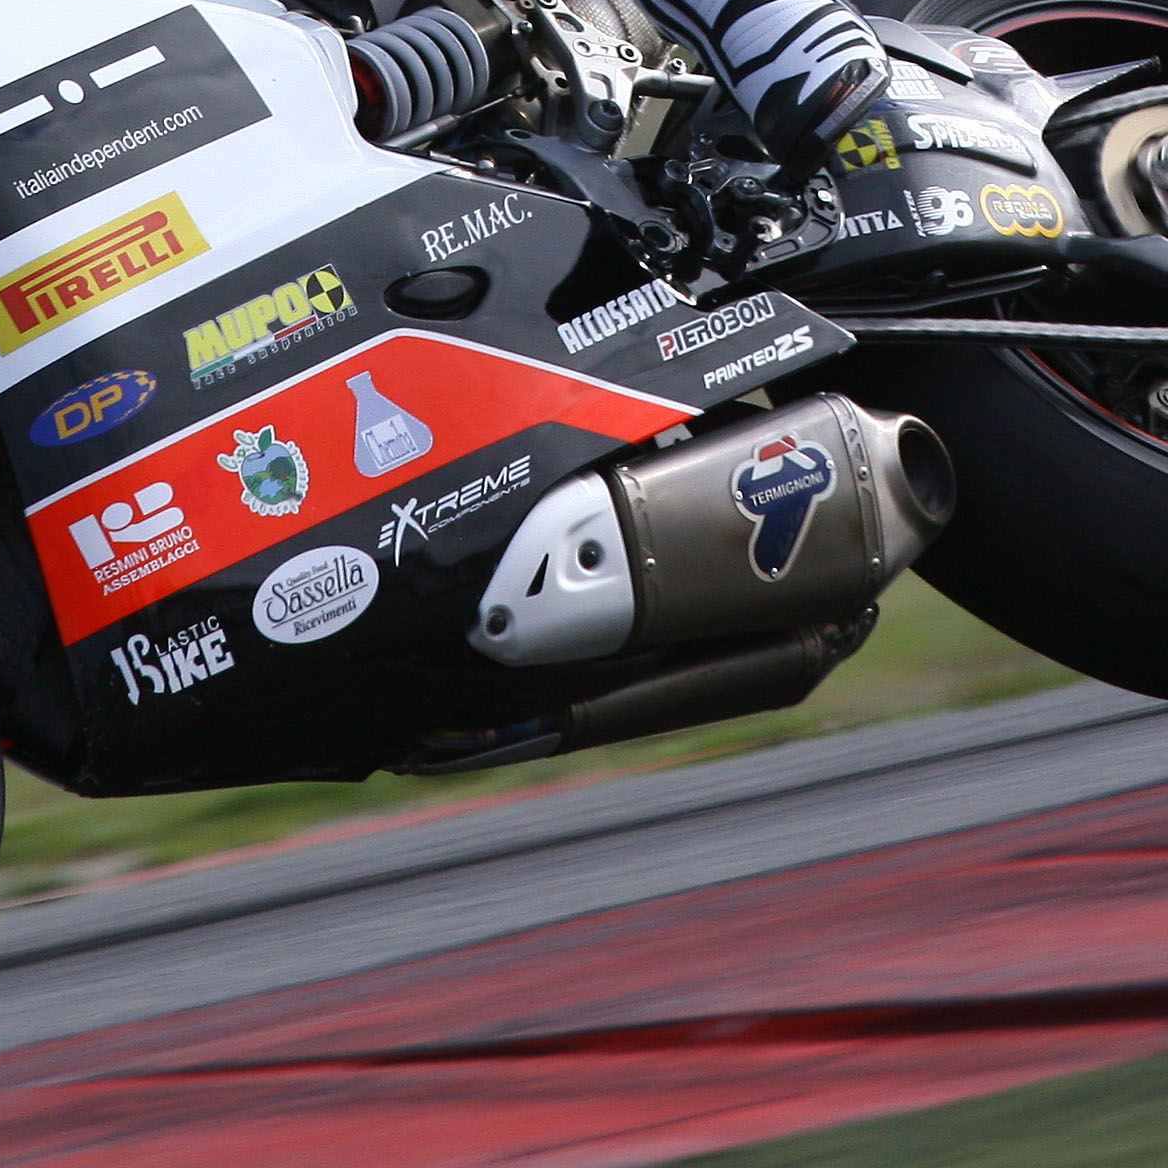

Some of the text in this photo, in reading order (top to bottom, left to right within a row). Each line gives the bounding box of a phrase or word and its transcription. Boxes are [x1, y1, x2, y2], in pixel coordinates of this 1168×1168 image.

[13, 102, 204, 200] italiaindependent.com
[420, 193, 533, 263] RE.MAC.
[836, 208, 904, 239] ITTA
[183, 281, 313, 372] MUPO
[557, 277, 678, 354] ACCOSSATO
[656, 292, 776, 361] PIEROBON
[54, 384, 123, 439] DP
[749, 471, 825, 507] TERMIGNONI
[93, 525, 193, 584] RESMINI BRUNO
[103, 538, 201, 597] ASSEMBLAGGI
[266, 554, 365, 623] Sassella
[293, 597, 357, 636] Ricevimenti
